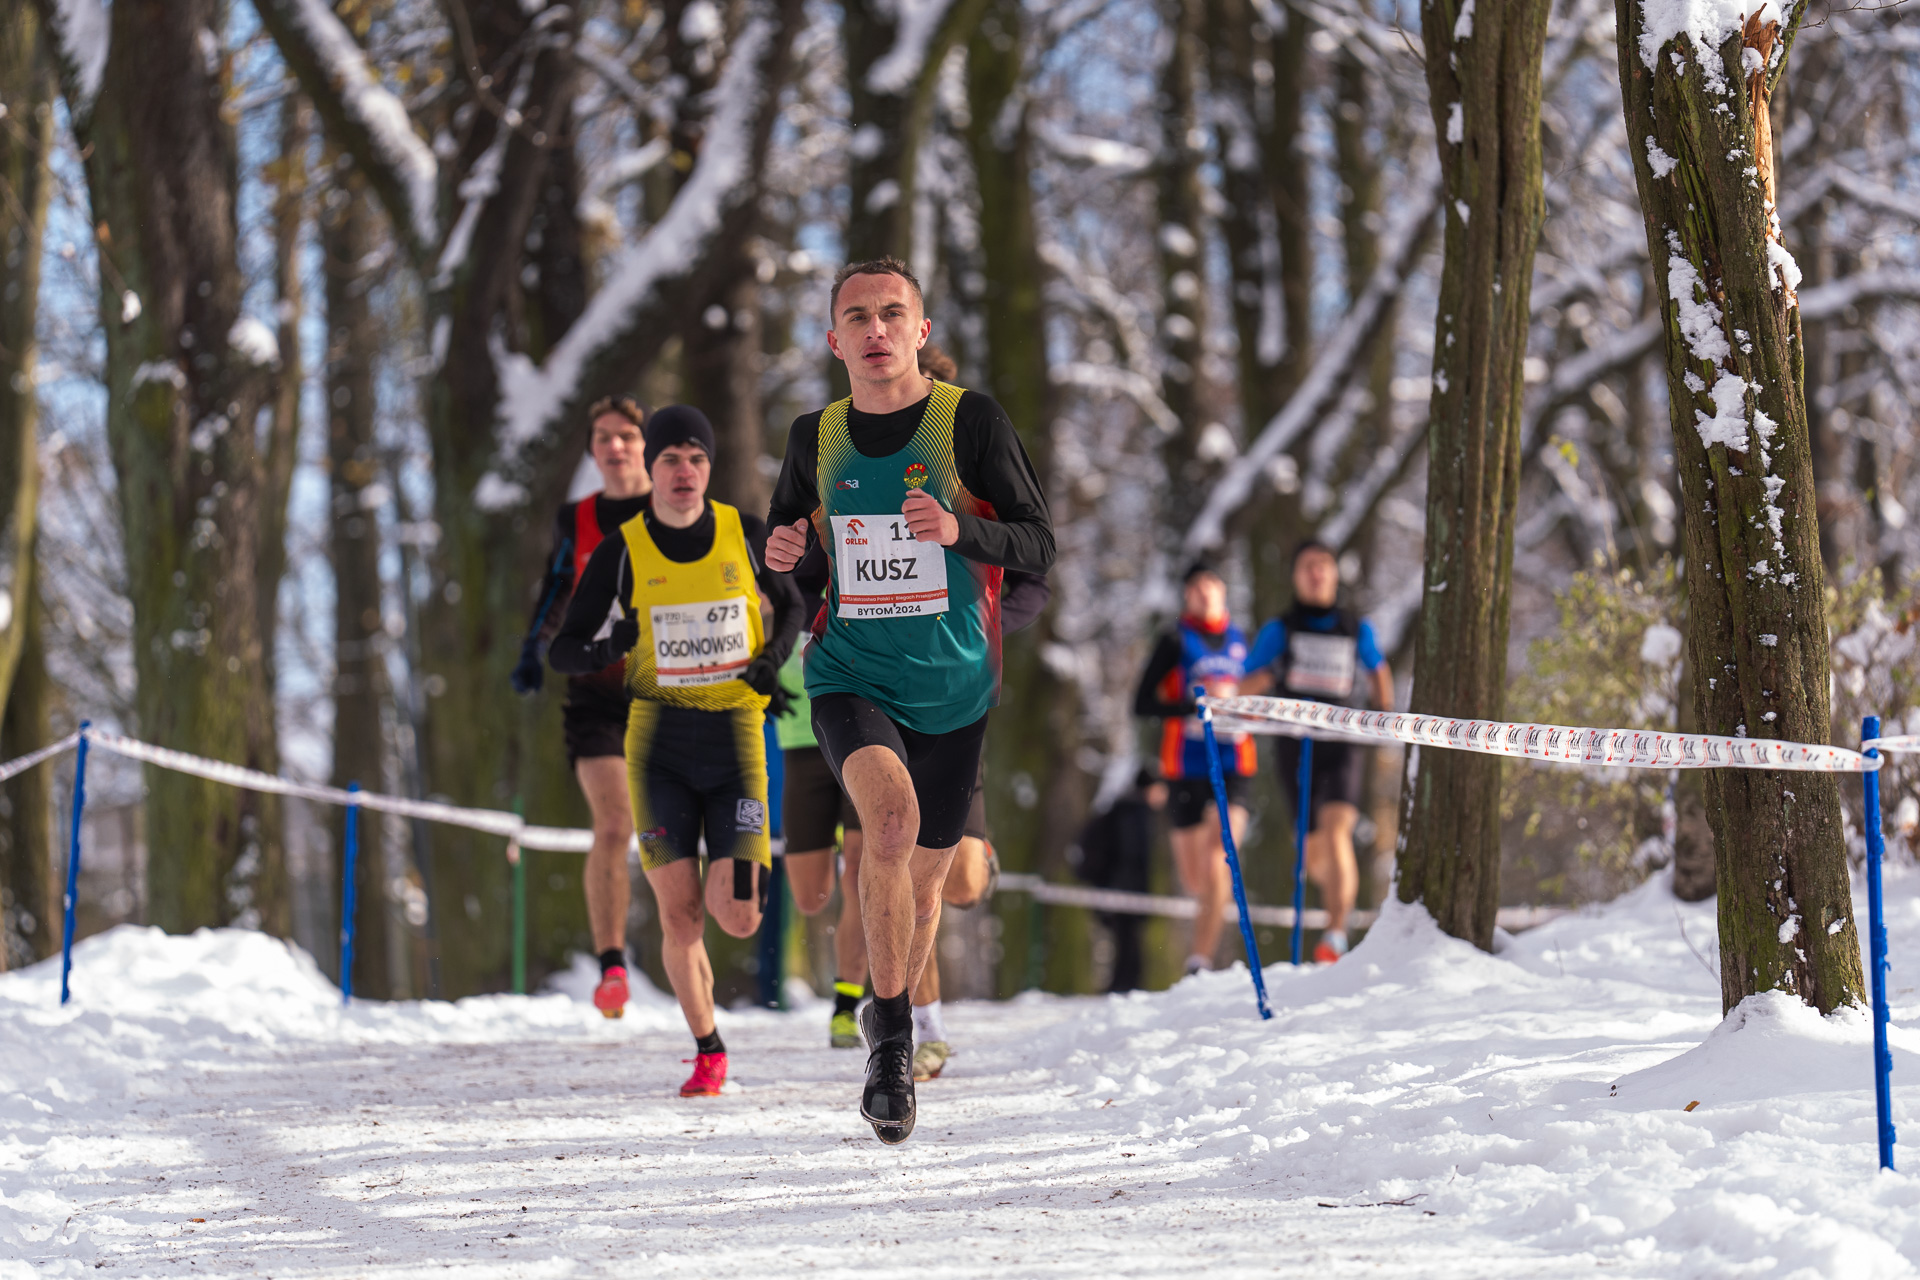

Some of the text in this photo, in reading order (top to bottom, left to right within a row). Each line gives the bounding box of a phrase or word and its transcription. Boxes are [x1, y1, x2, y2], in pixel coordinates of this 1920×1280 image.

[845, 537, 868, 545] ORLEN
[856, 557, 919, 582] KUSZ
[707, 604, 740, 623] 673
[857, 604, 922, 616] BYTOM 2024
[658, 631, 744, 658] OGONOWSKI
